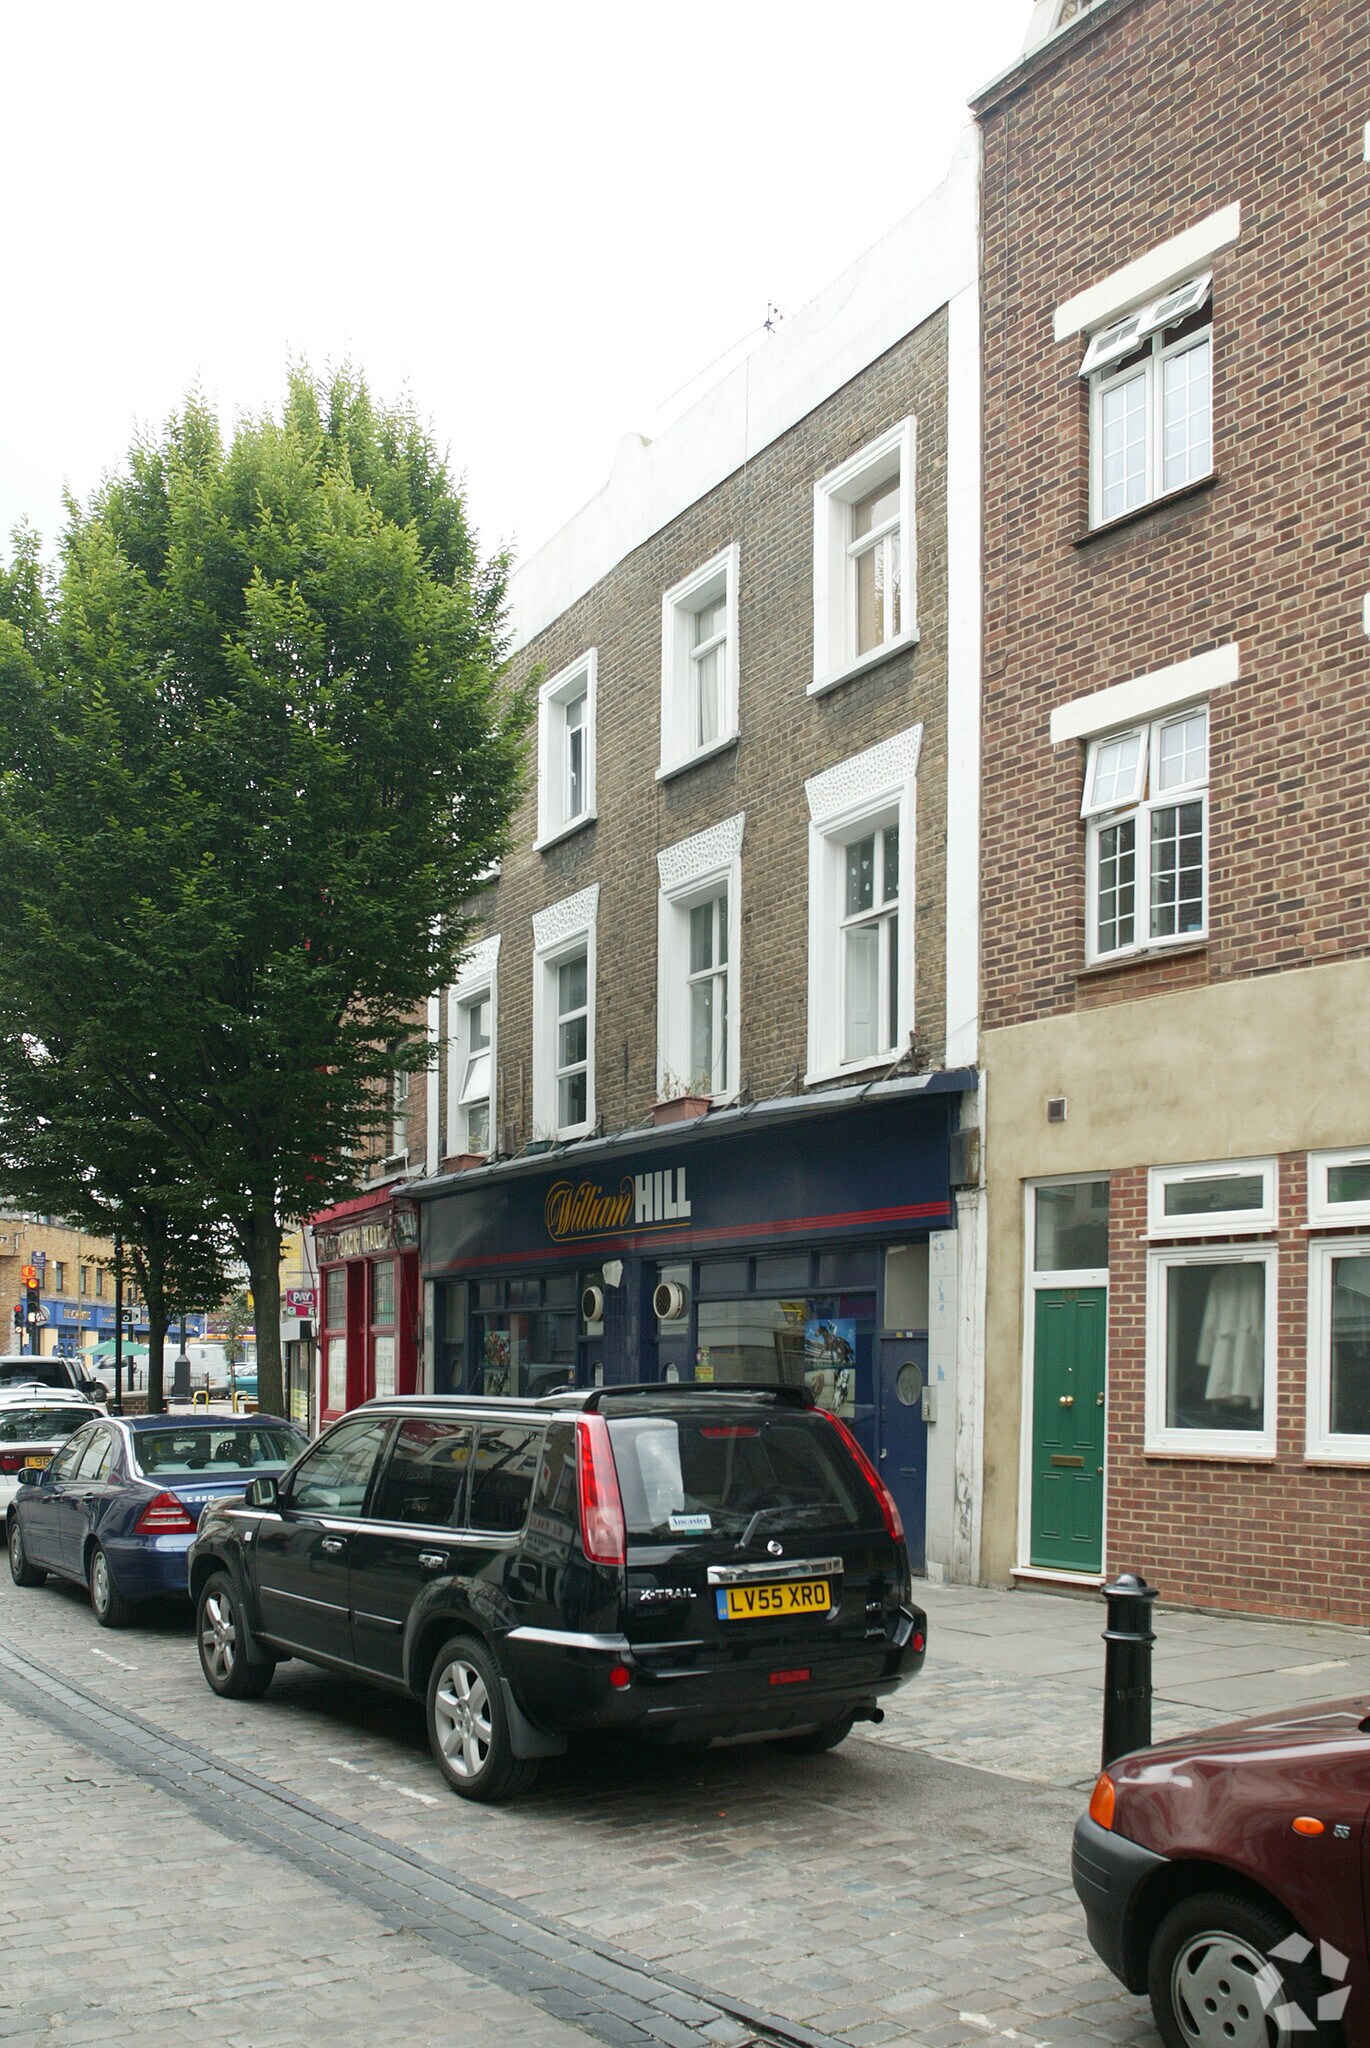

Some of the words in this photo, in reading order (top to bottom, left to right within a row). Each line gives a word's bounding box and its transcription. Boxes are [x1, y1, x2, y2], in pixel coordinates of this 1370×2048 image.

[545, 1175, 635, 1239] William
[635, 1167, 691, 1223] HILL
[293, 1291, 312, 1303] PAY
[195, 1494, 215, 1502] 220
[672, 1516, 708, 1526] Ancaster
[640, 1587, 697, 1601] X-TRAIL
[730, 1588, 783, 1613] LV55
[788, 1584, 826, 1607] XRO
